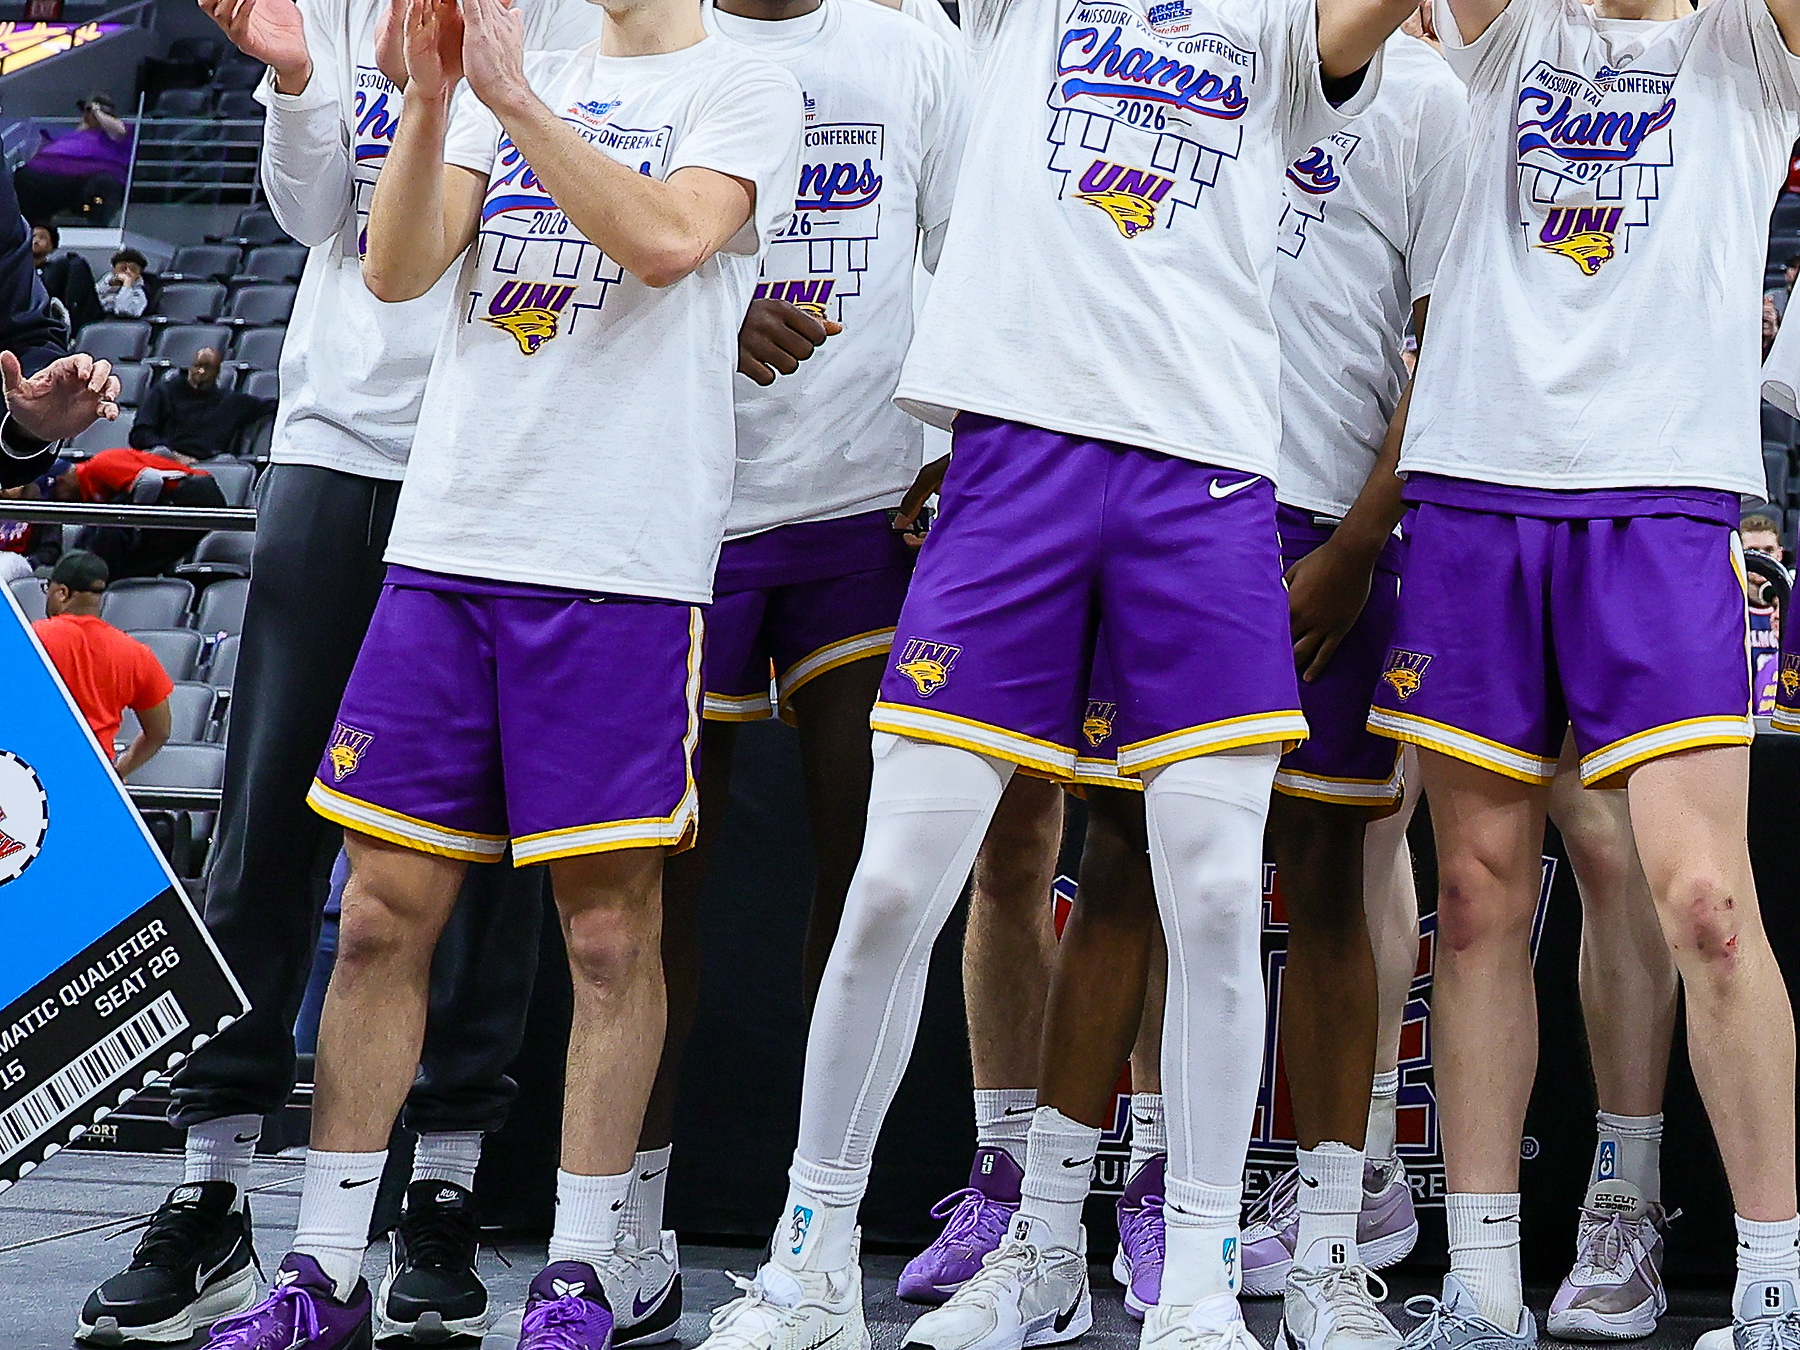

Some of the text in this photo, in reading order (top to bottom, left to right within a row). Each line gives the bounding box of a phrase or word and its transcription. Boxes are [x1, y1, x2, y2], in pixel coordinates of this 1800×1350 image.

[1077, 9, 1132, 26] MISSOURI
[1177, 39, 1249, 67] CONFERENCE
[1057, 26, 1249, 120] Champs
[1535, 68, 1582, 98] MISSOURI
[1115, 100, 1166, 130] 2026
[805, 129, 877, 147] CONFERENCE
[1079, 160, 1175, 203] UNI
[528, 211, 569, 235] 2026
[1540, 206, 1625, 242] UNI
[489, 280, 579, 316] UNI
[899, 638, 961, 669] UNI
[58, 919, 168, 1006] QUALIFIER
[94, 946, 180, 1017] SEAT 26
[1614, 1196, 1638, 1205] CUT
